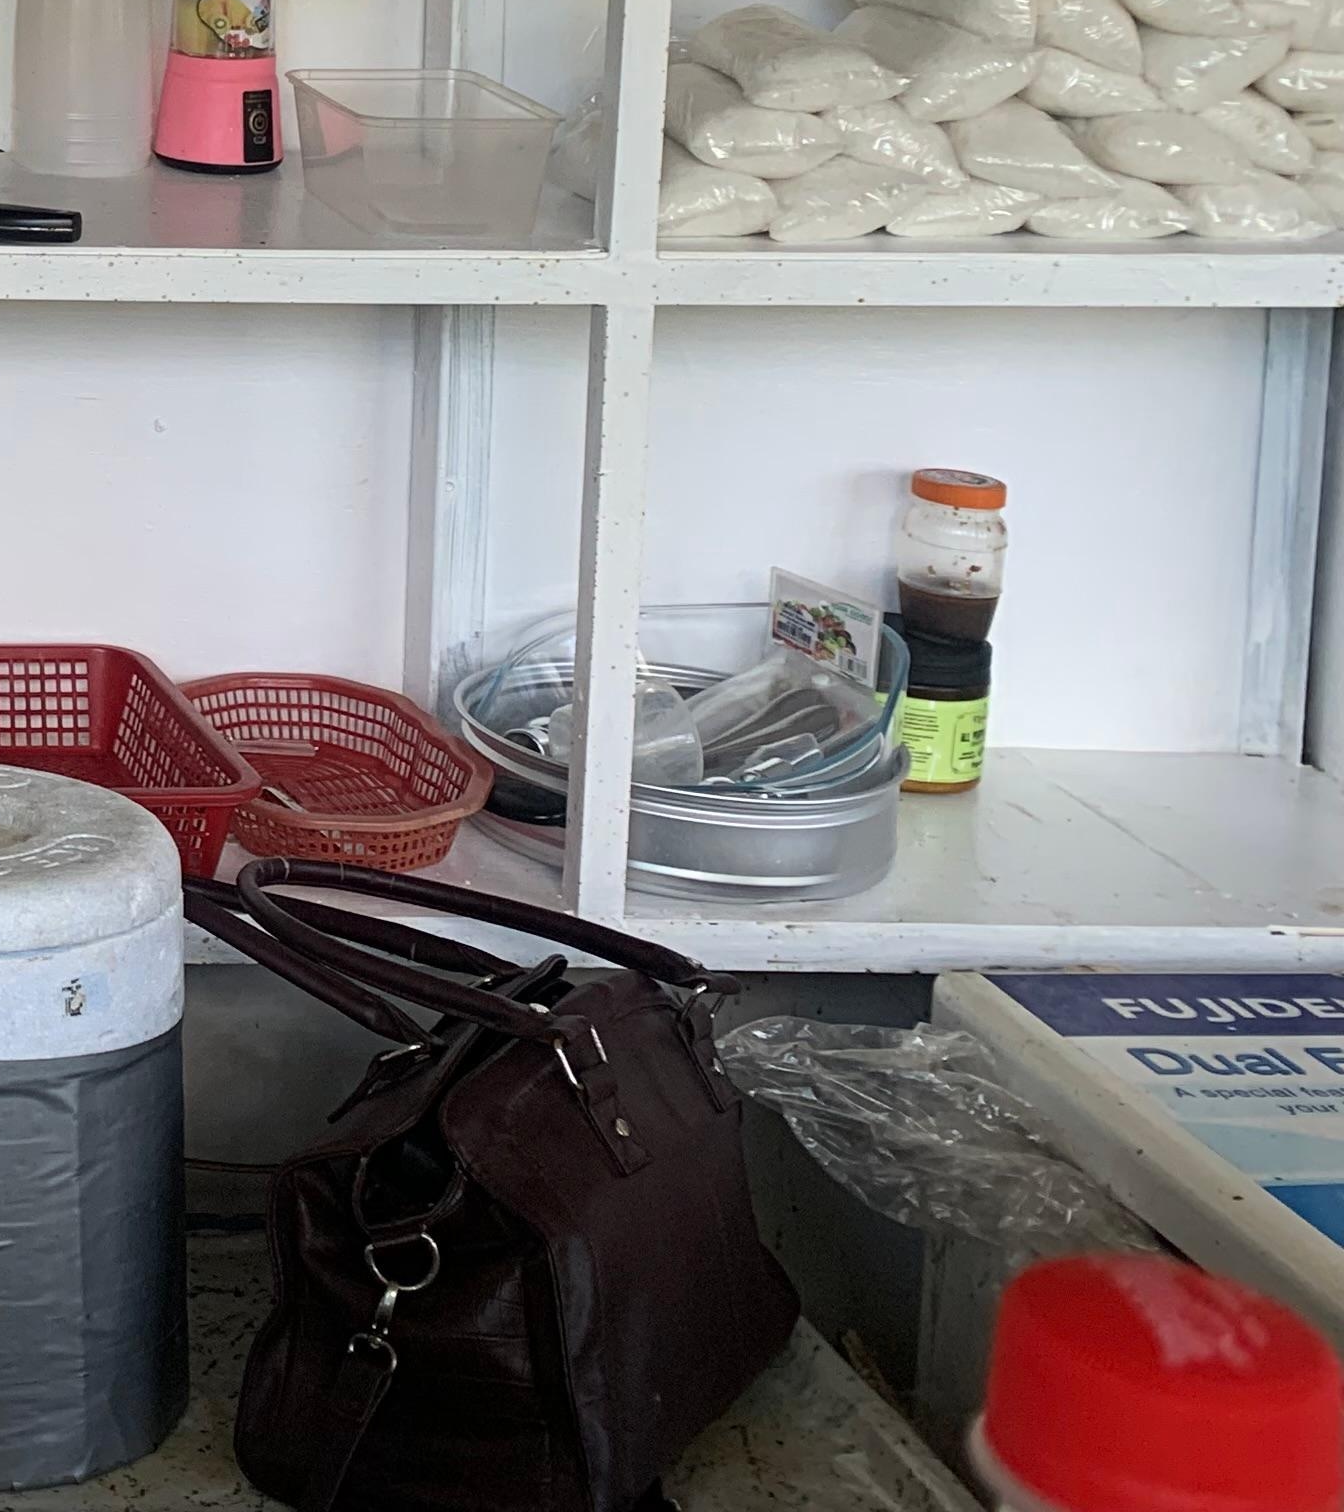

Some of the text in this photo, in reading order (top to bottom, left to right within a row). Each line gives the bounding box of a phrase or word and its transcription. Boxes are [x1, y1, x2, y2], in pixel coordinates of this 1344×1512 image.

[1101, 997, 1344, 1024] FUJIDE
[1126, 1046, 1308, 1077] Dual
[1173, 1087, 1197, 1099] A
[1202, 1086, 1294, 1101] special
[1277, 1102, 1338, 1117] your
